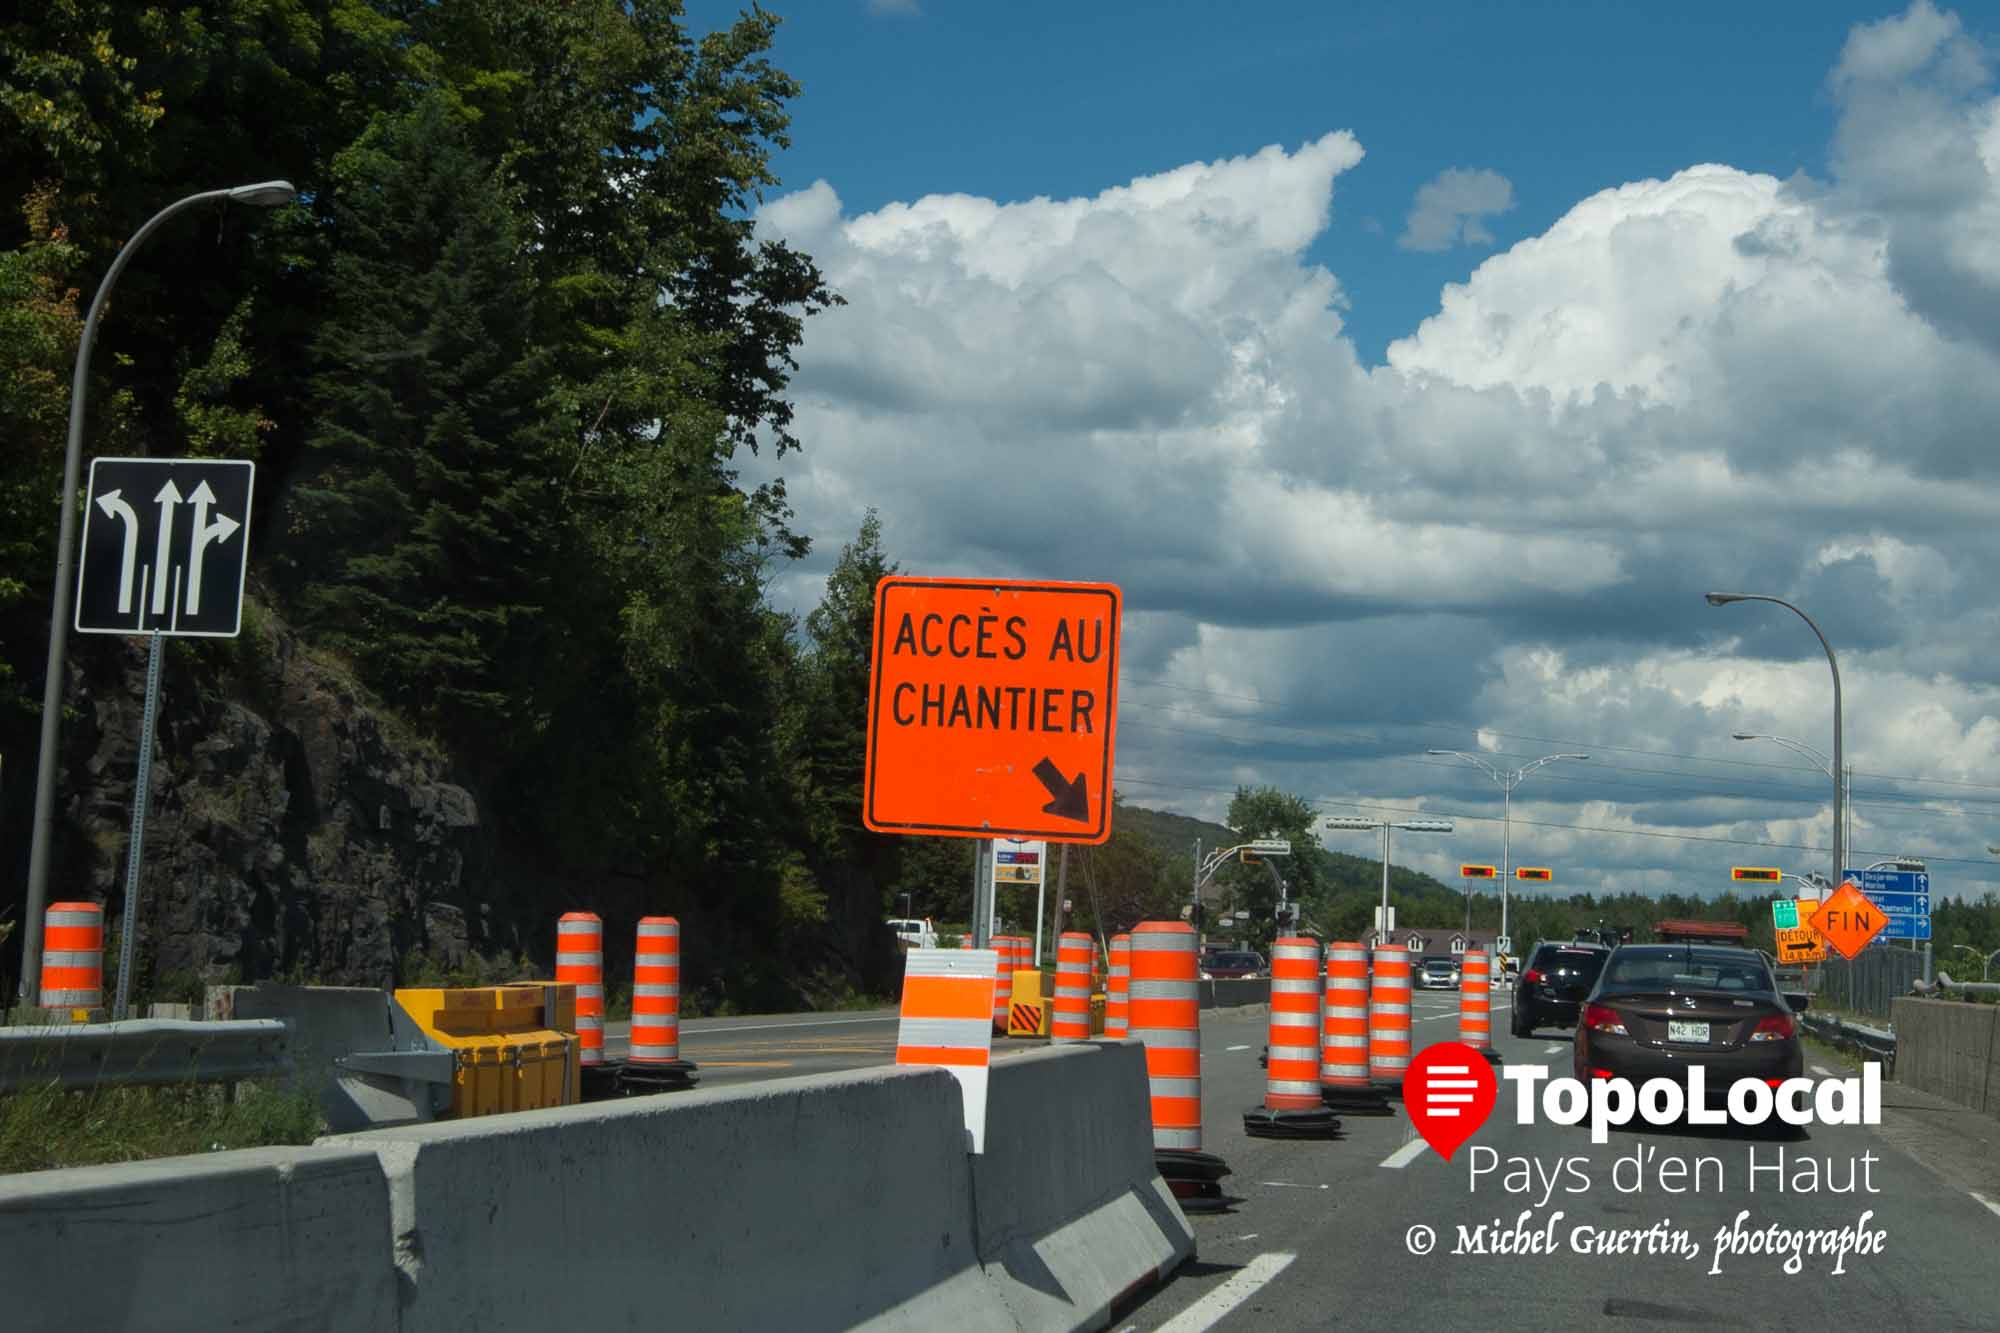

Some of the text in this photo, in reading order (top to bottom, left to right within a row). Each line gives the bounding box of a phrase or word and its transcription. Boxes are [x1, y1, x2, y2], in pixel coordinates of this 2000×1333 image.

[893, 607, 1102, 664] ACCÈS AU
[892, 681, 1095, 734] CHANTIER
[1827, 911, 1869, 931] FIN
[1669, 1023, 1687, 1036] N42
